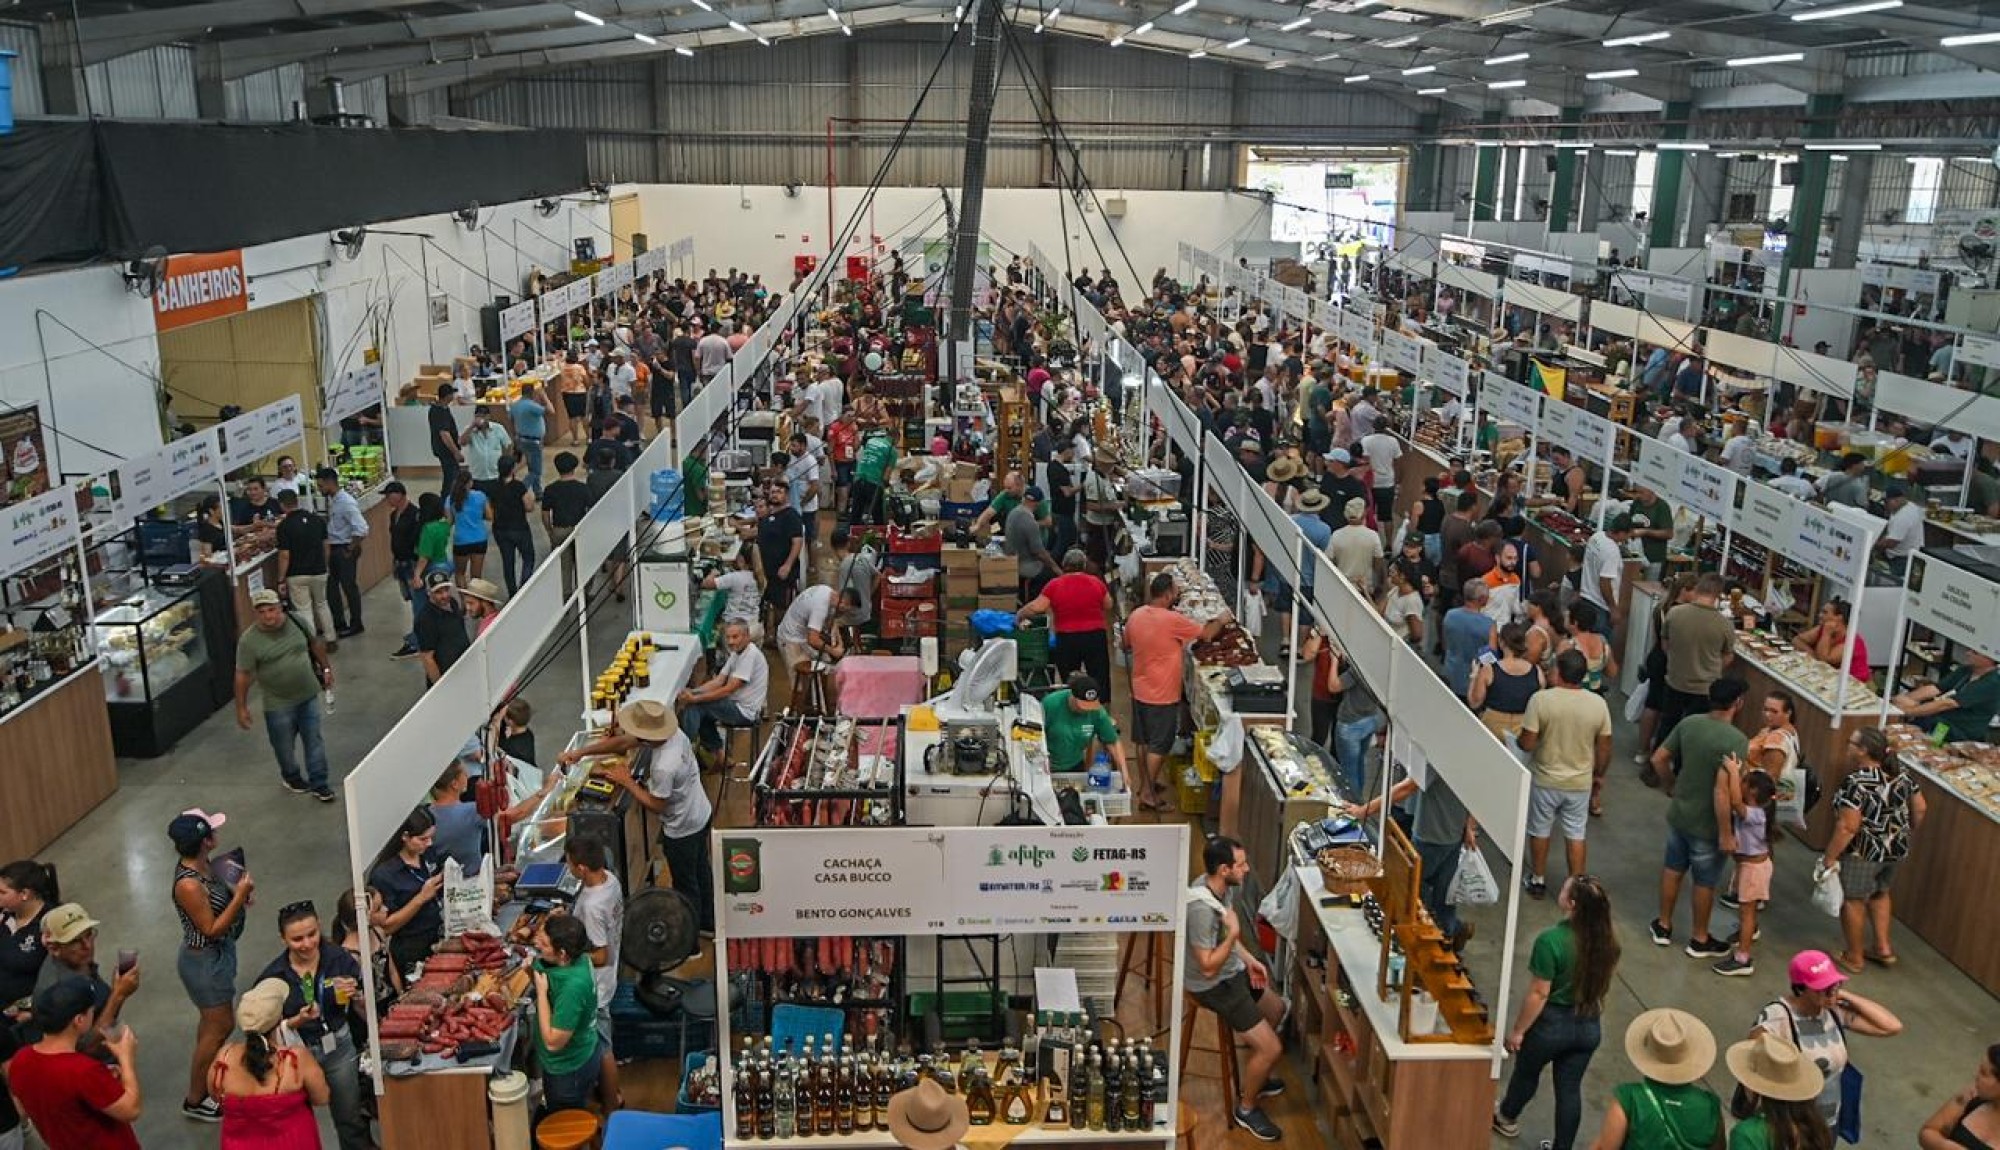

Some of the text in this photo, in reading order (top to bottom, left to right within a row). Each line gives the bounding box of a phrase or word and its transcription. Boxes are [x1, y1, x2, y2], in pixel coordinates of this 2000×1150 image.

[157, 265, 242, 312] BANHEIROS
[1093, 847, 1146, 860] FETAG-RS
[823, 858, 882, 870] CACHAÇA
[815, 872, 892, 883] CASA BUCCO
[796, 907, 912, 920] BENTO GONÇALVES
